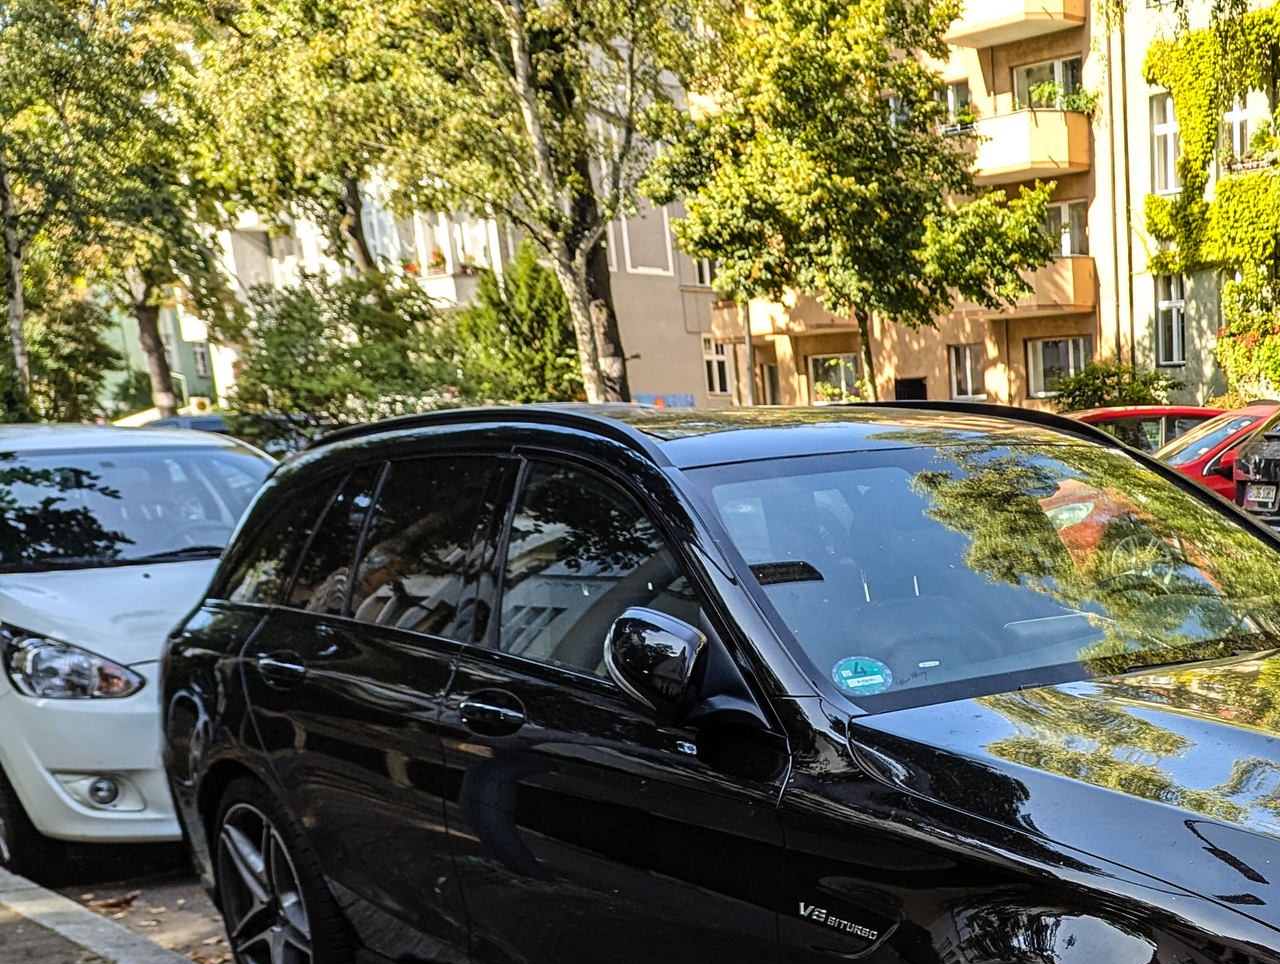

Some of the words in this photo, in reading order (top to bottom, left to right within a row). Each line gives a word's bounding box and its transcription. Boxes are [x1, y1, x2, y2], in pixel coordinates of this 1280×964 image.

[853, 661, 868, 676] 4
[798, 901, 828, 922] V8
[827, 915, 879, 940] BITURBO
